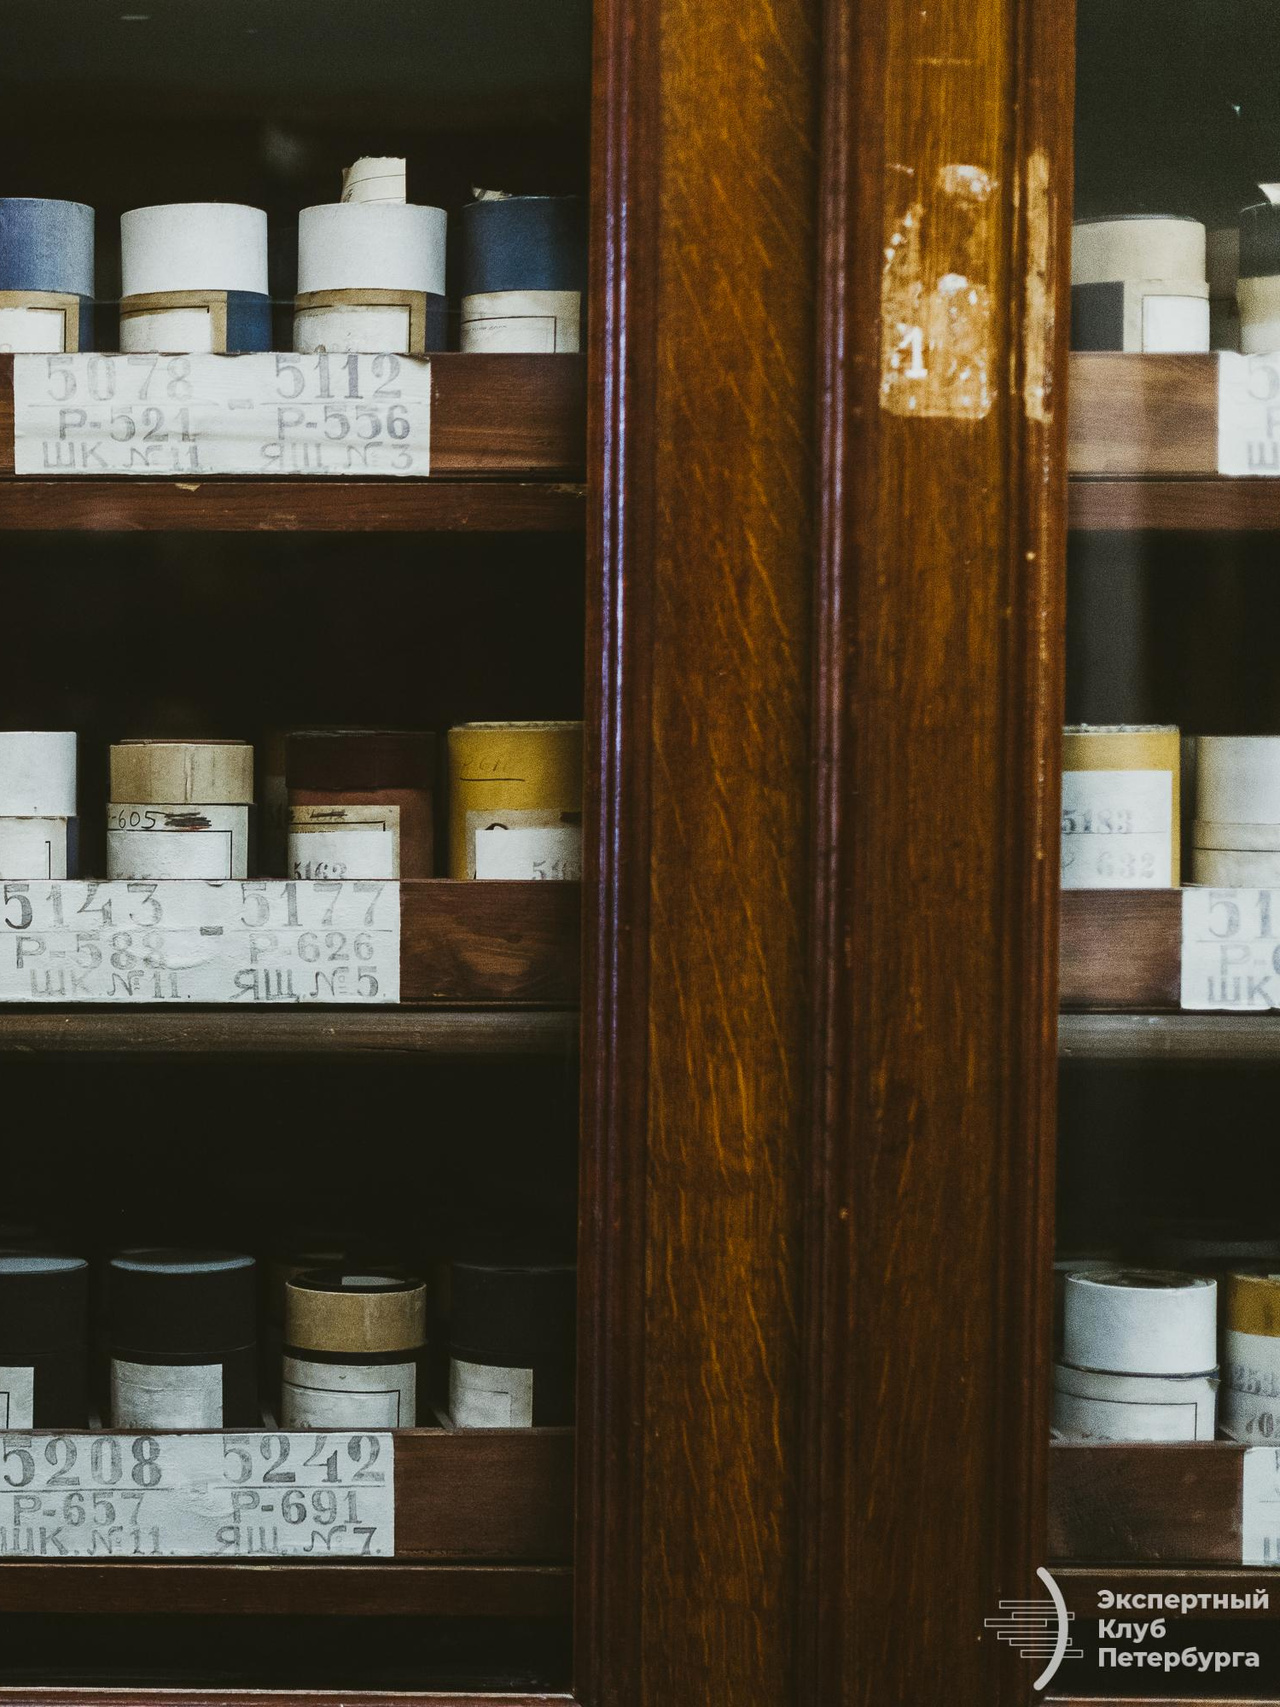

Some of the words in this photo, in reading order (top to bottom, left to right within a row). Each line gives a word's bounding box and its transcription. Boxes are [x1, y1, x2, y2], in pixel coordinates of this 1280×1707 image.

[47, 356, 193, 401] 5078
[275, 353, 402, 399] 5112
[277, 405, 411, 440] Р-556
[3, 883, 164, 929] 5143
[240, 883, 385, 928] 5177
[248, 931, 374, 965] Р-626
[2, 1436, 162, 1487] 5208
[222, 1434, 386, 1484] 5242
[13, 1491, 146, 1527] Р-657
[231, 1489, 363, 1525] Р-691
